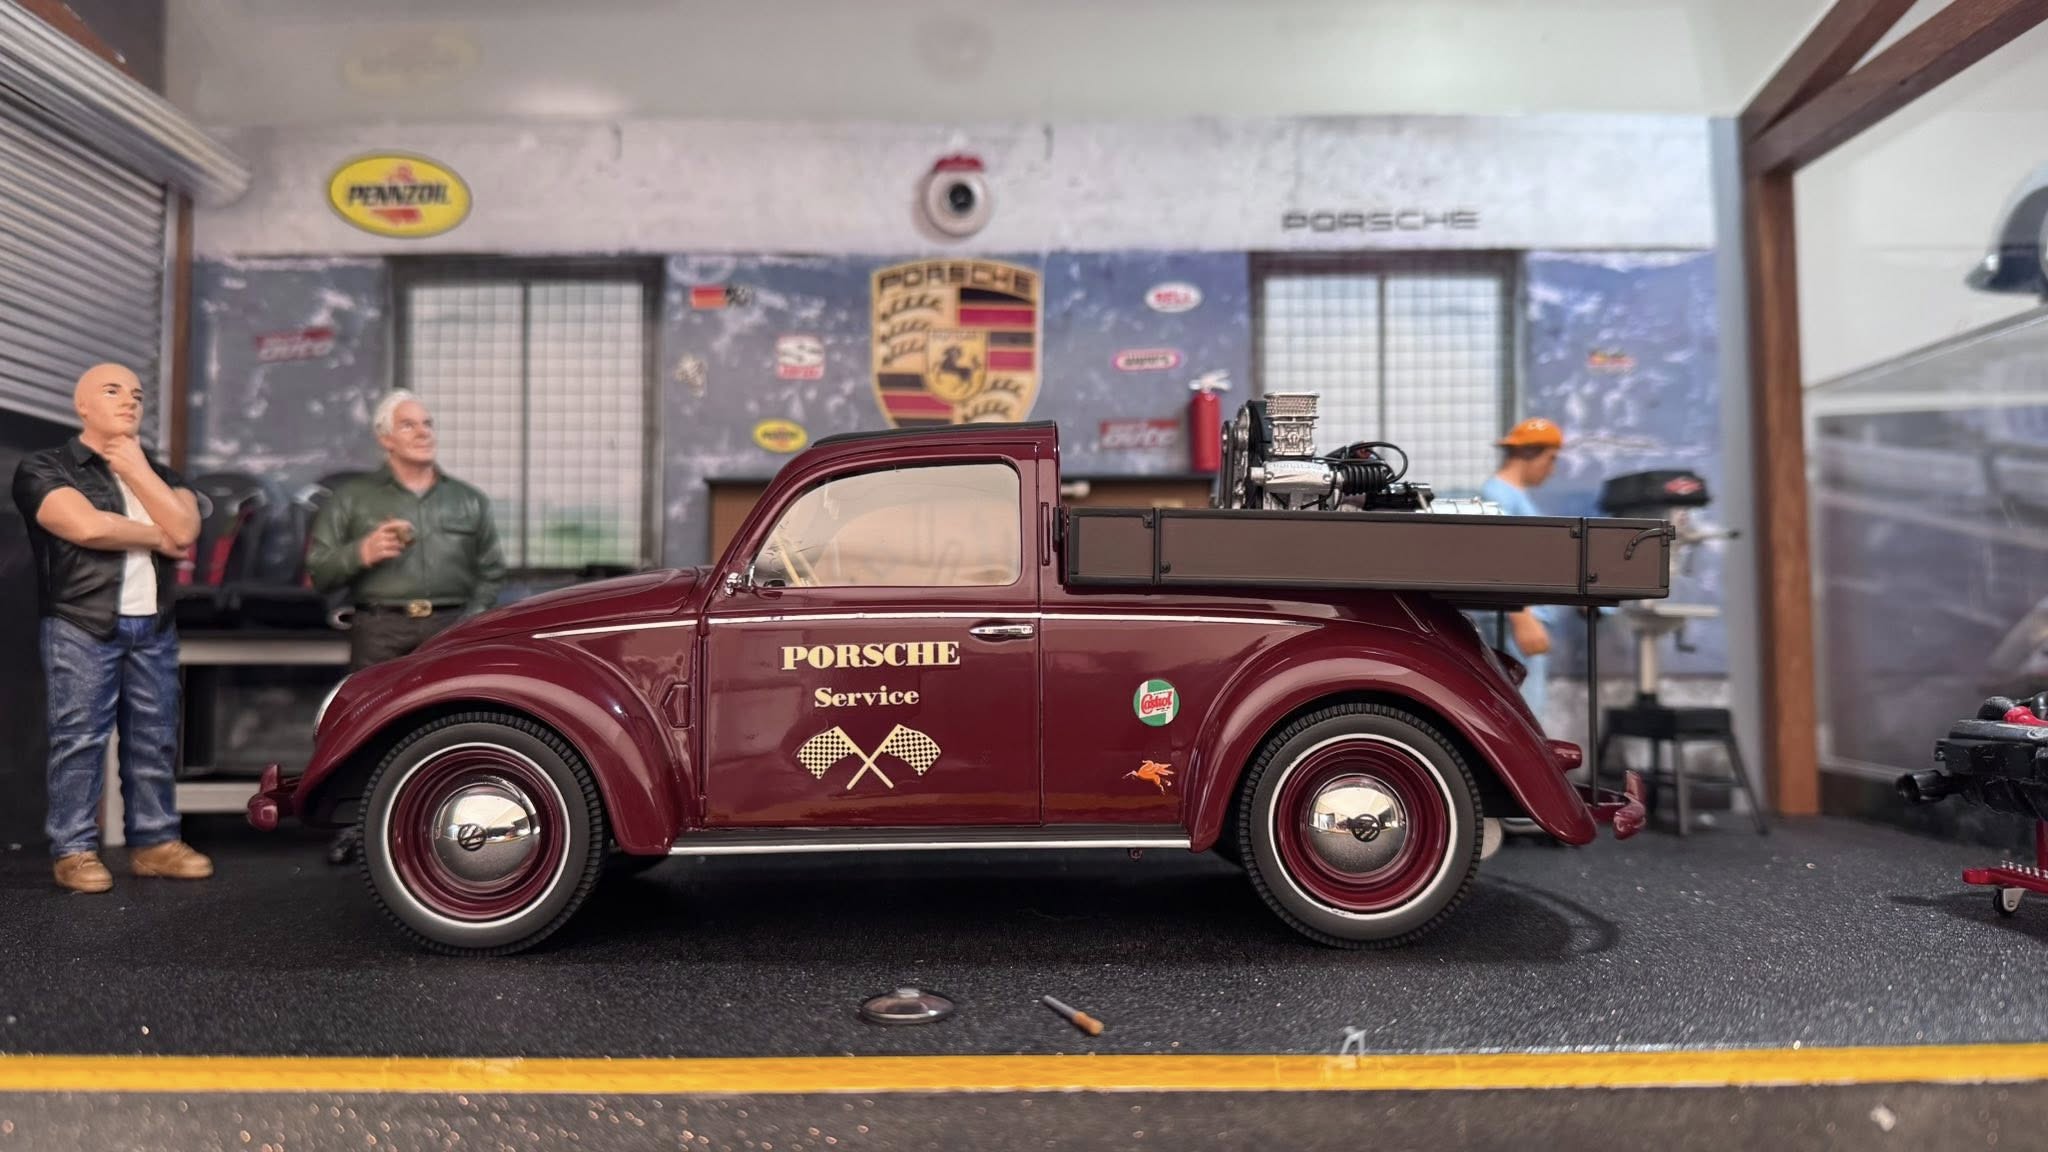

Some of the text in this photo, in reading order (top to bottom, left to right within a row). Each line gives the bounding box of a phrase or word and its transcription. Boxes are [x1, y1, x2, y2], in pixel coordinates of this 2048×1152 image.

[347, 183, 450, 207] PENNZOIL
[1282, 210, 1480, 232] PORSCHE
[879, 263, 1032, 296] PORSCHE
[781, 641, 961, 671] PORSCHE
[814, 685, 920, 708] Service
[1141, 690, 1173, 714] Castrol
